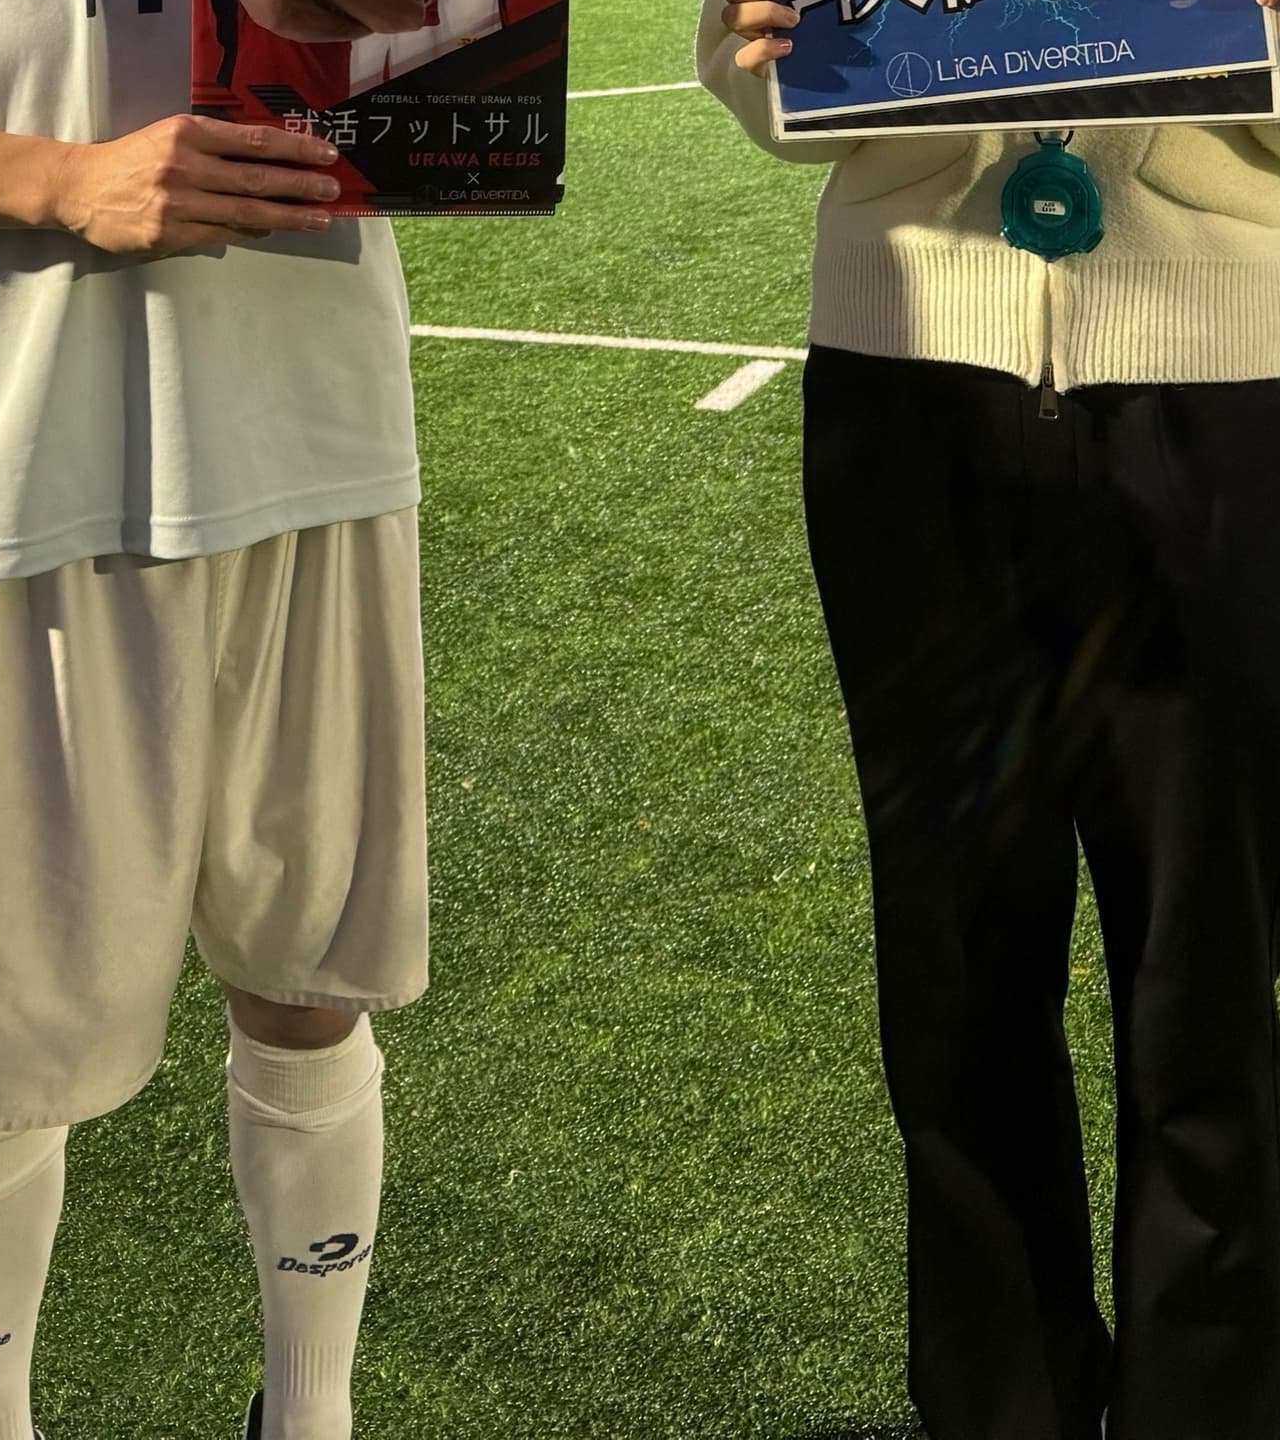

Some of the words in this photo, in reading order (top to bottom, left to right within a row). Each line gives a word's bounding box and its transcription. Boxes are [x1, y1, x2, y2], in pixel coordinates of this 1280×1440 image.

[371, 94, 420, 105] FOOTBALL
[427, 94, 477, 105] TOGETHER
[481, 95, 512, 105] URAWA
[517, 95, 543, 106] REDS
[282, 108, 550, 145] 就活フットサル
[408, 152, 480, 167] URAWA
[488, 152, 542, 167] REDS
